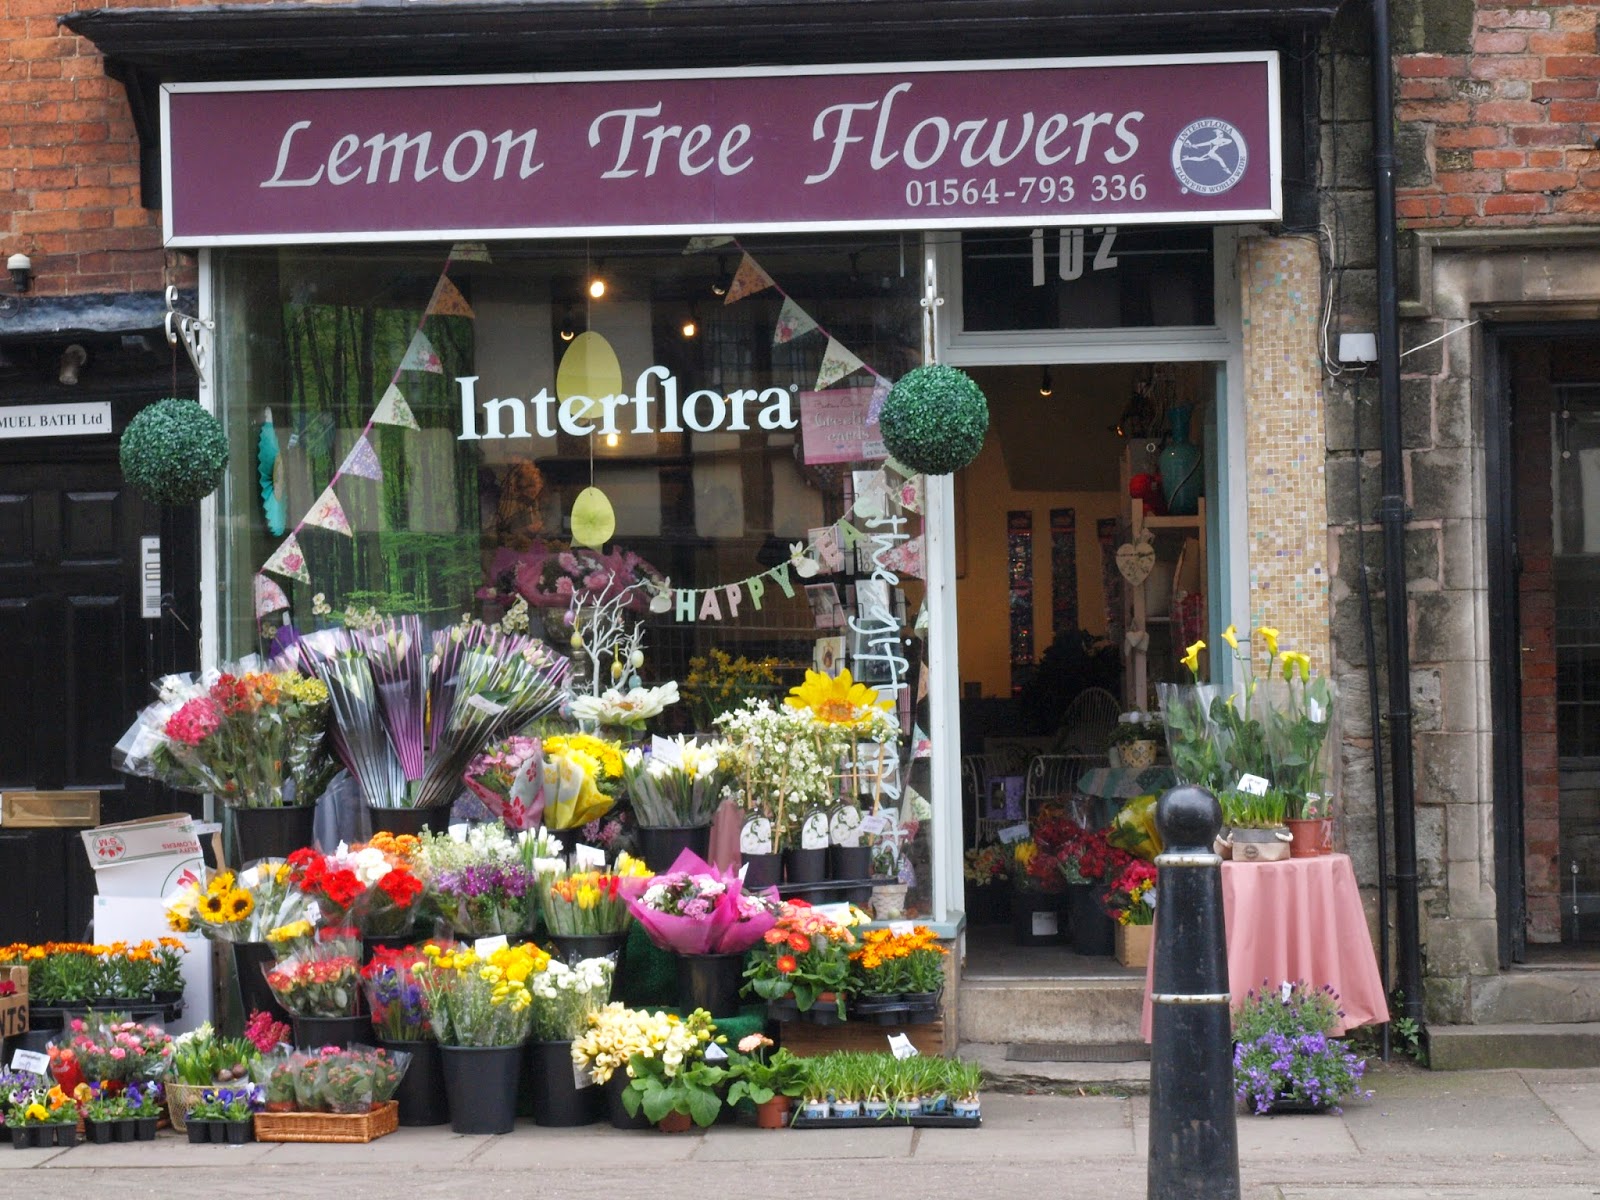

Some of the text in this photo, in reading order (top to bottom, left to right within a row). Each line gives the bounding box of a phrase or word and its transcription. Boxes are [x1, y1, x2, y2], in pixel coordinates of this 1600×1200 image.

[259, 82, 1145, 188] Lemon Tree Flowers
[1179, 120, 1234, 143] INTERFLORA
[905, 173, 1147, 206] 01564-793 336
[1175, 155, 1246, 193] FLOWERS WORLD WIDE
[1030, 226, 1118, 288] 102
[0, 412, 103, 429] MUEL BATH Ltd
[864, 513, 911, 589] the
[675, 562, 796, 622] HAPPY
[848, 602, 912, 700] gift
